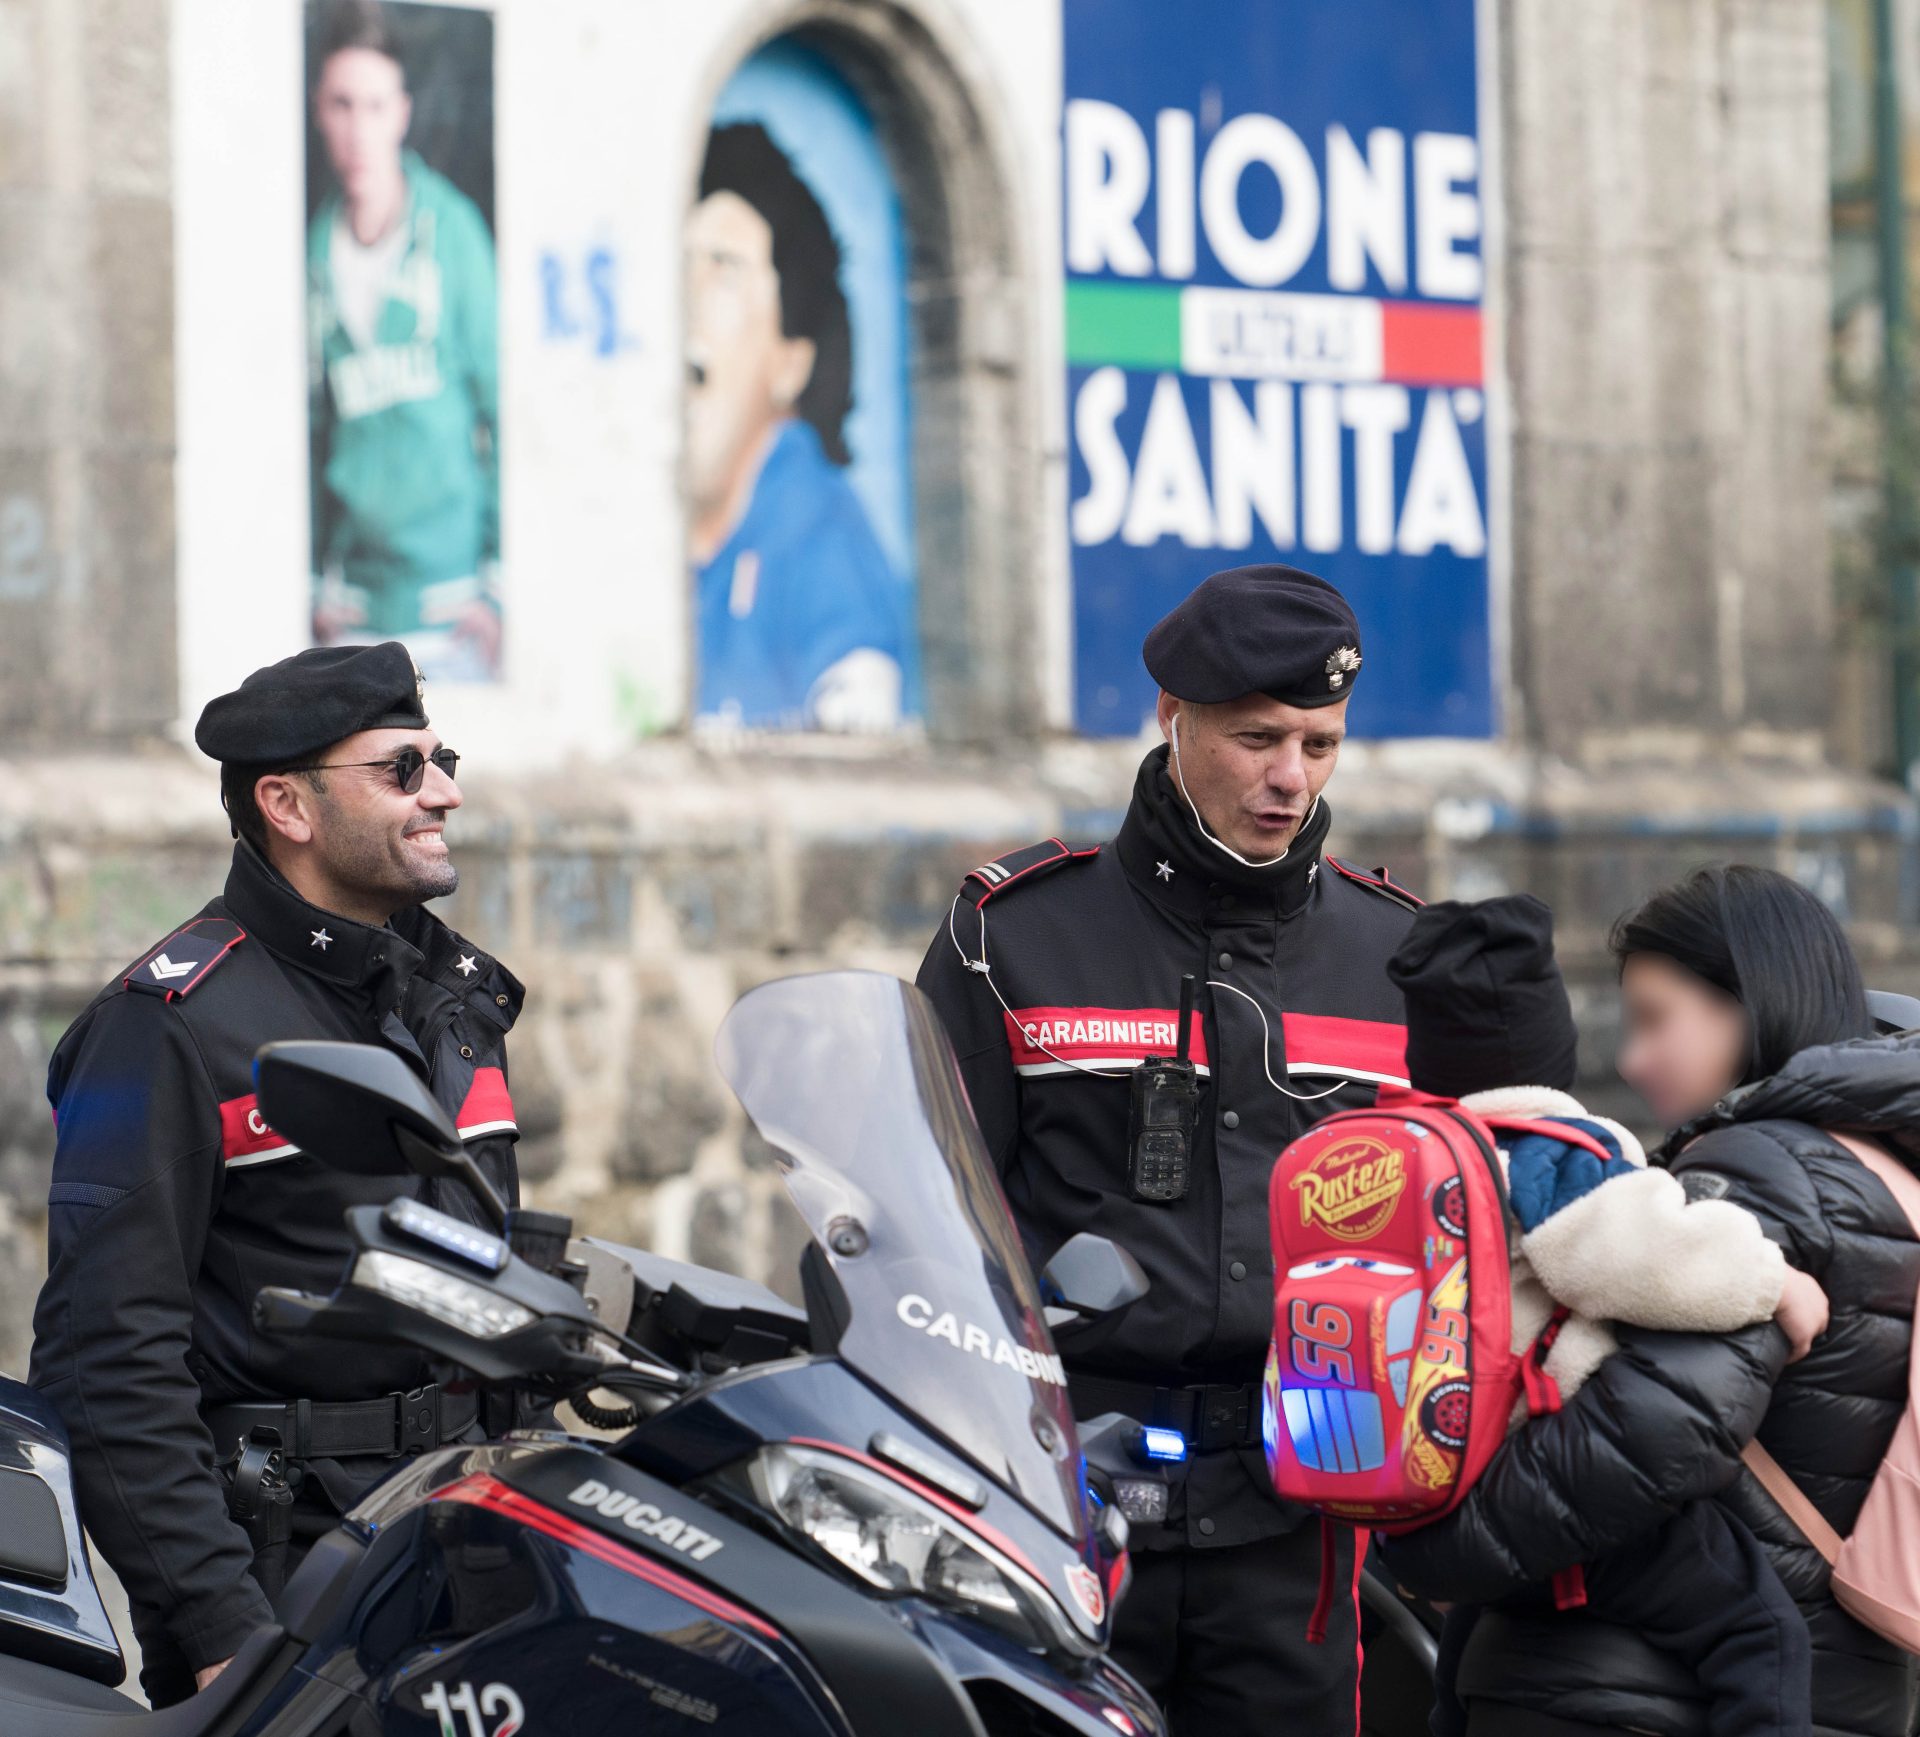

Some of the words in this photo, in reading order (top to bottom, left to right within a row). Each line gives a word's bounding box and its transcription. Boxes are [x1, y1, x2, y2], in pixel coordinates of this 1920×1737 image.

[1067, 98, 1483, 299] RIONE
[1023, 1019, 1178, 1049] CARABINIERI
[1291, 1298, 1356, 1387] 95
[1423, 1307, 1468, 1368] 95
[568, 1479, 724, 1561] DUCATI
[421, 1680, 526, 1737] 112
